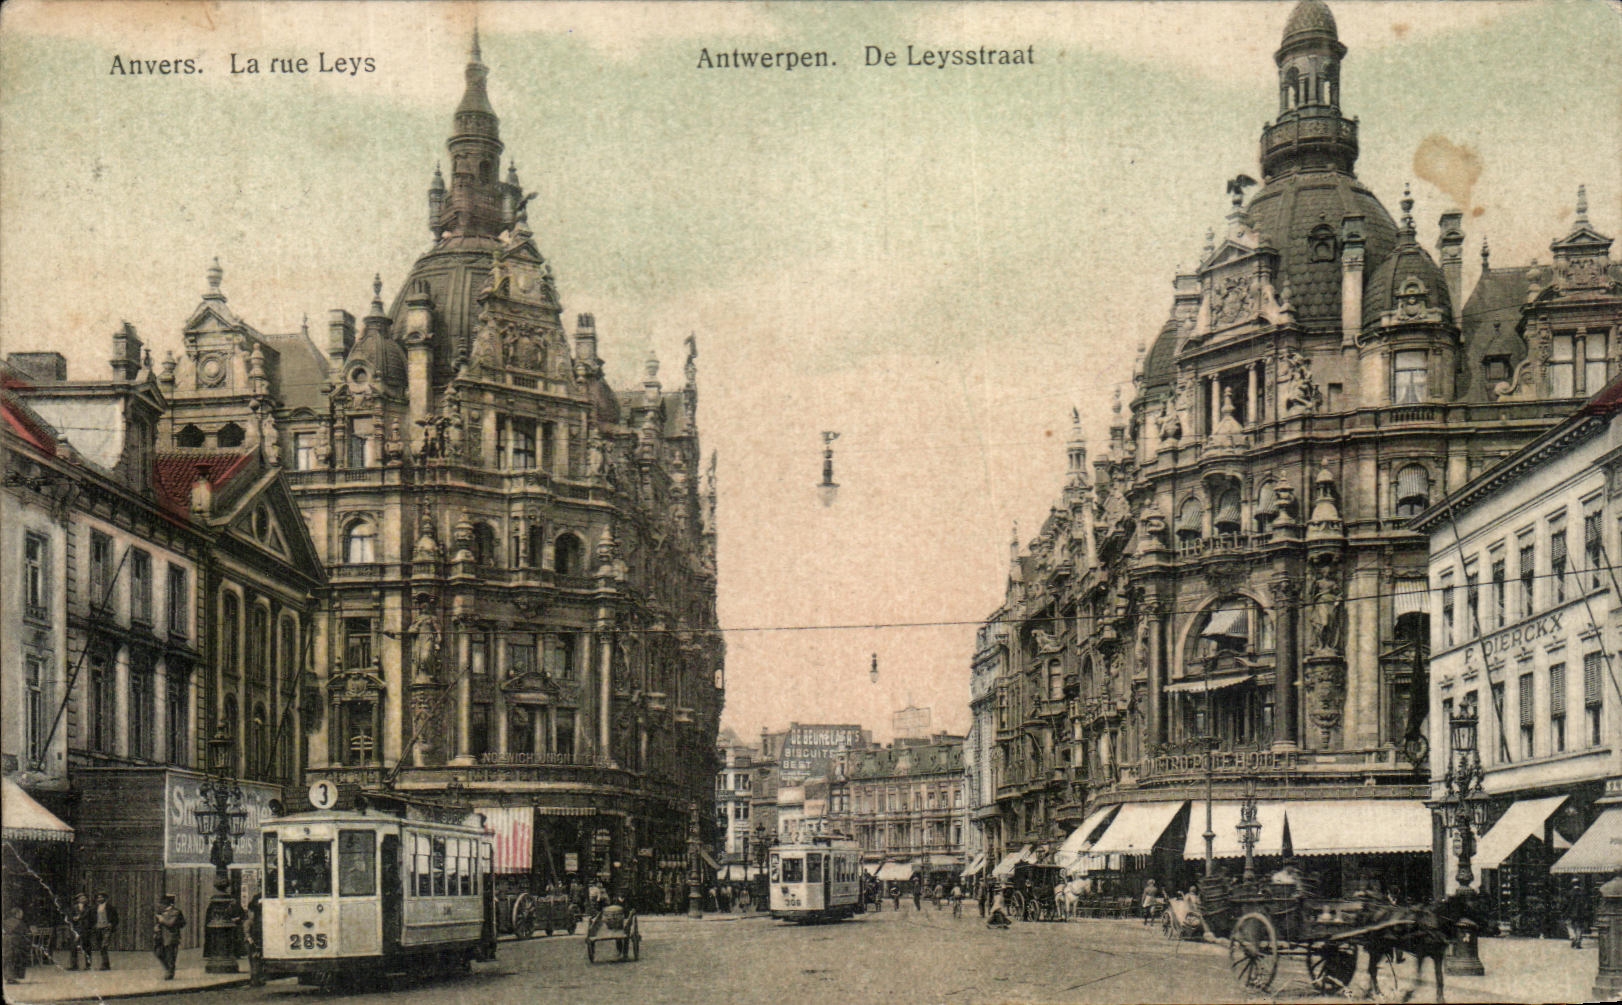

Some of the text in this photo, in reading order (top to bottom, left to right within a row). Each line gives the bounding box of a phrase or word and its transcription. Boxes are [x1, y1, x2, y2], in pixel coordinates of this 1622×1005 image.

[1484, 613, 1563, 657] DIERCKX
[784, 748, 835, 759] BISCUITS
[783, 760, 812, 769] BEST
[318, 784, 328, 805] 3
[175, 833, 205, 854] GRAND
[794, 831, 800, 842] 2
[290, 933, 328, 950] 285
